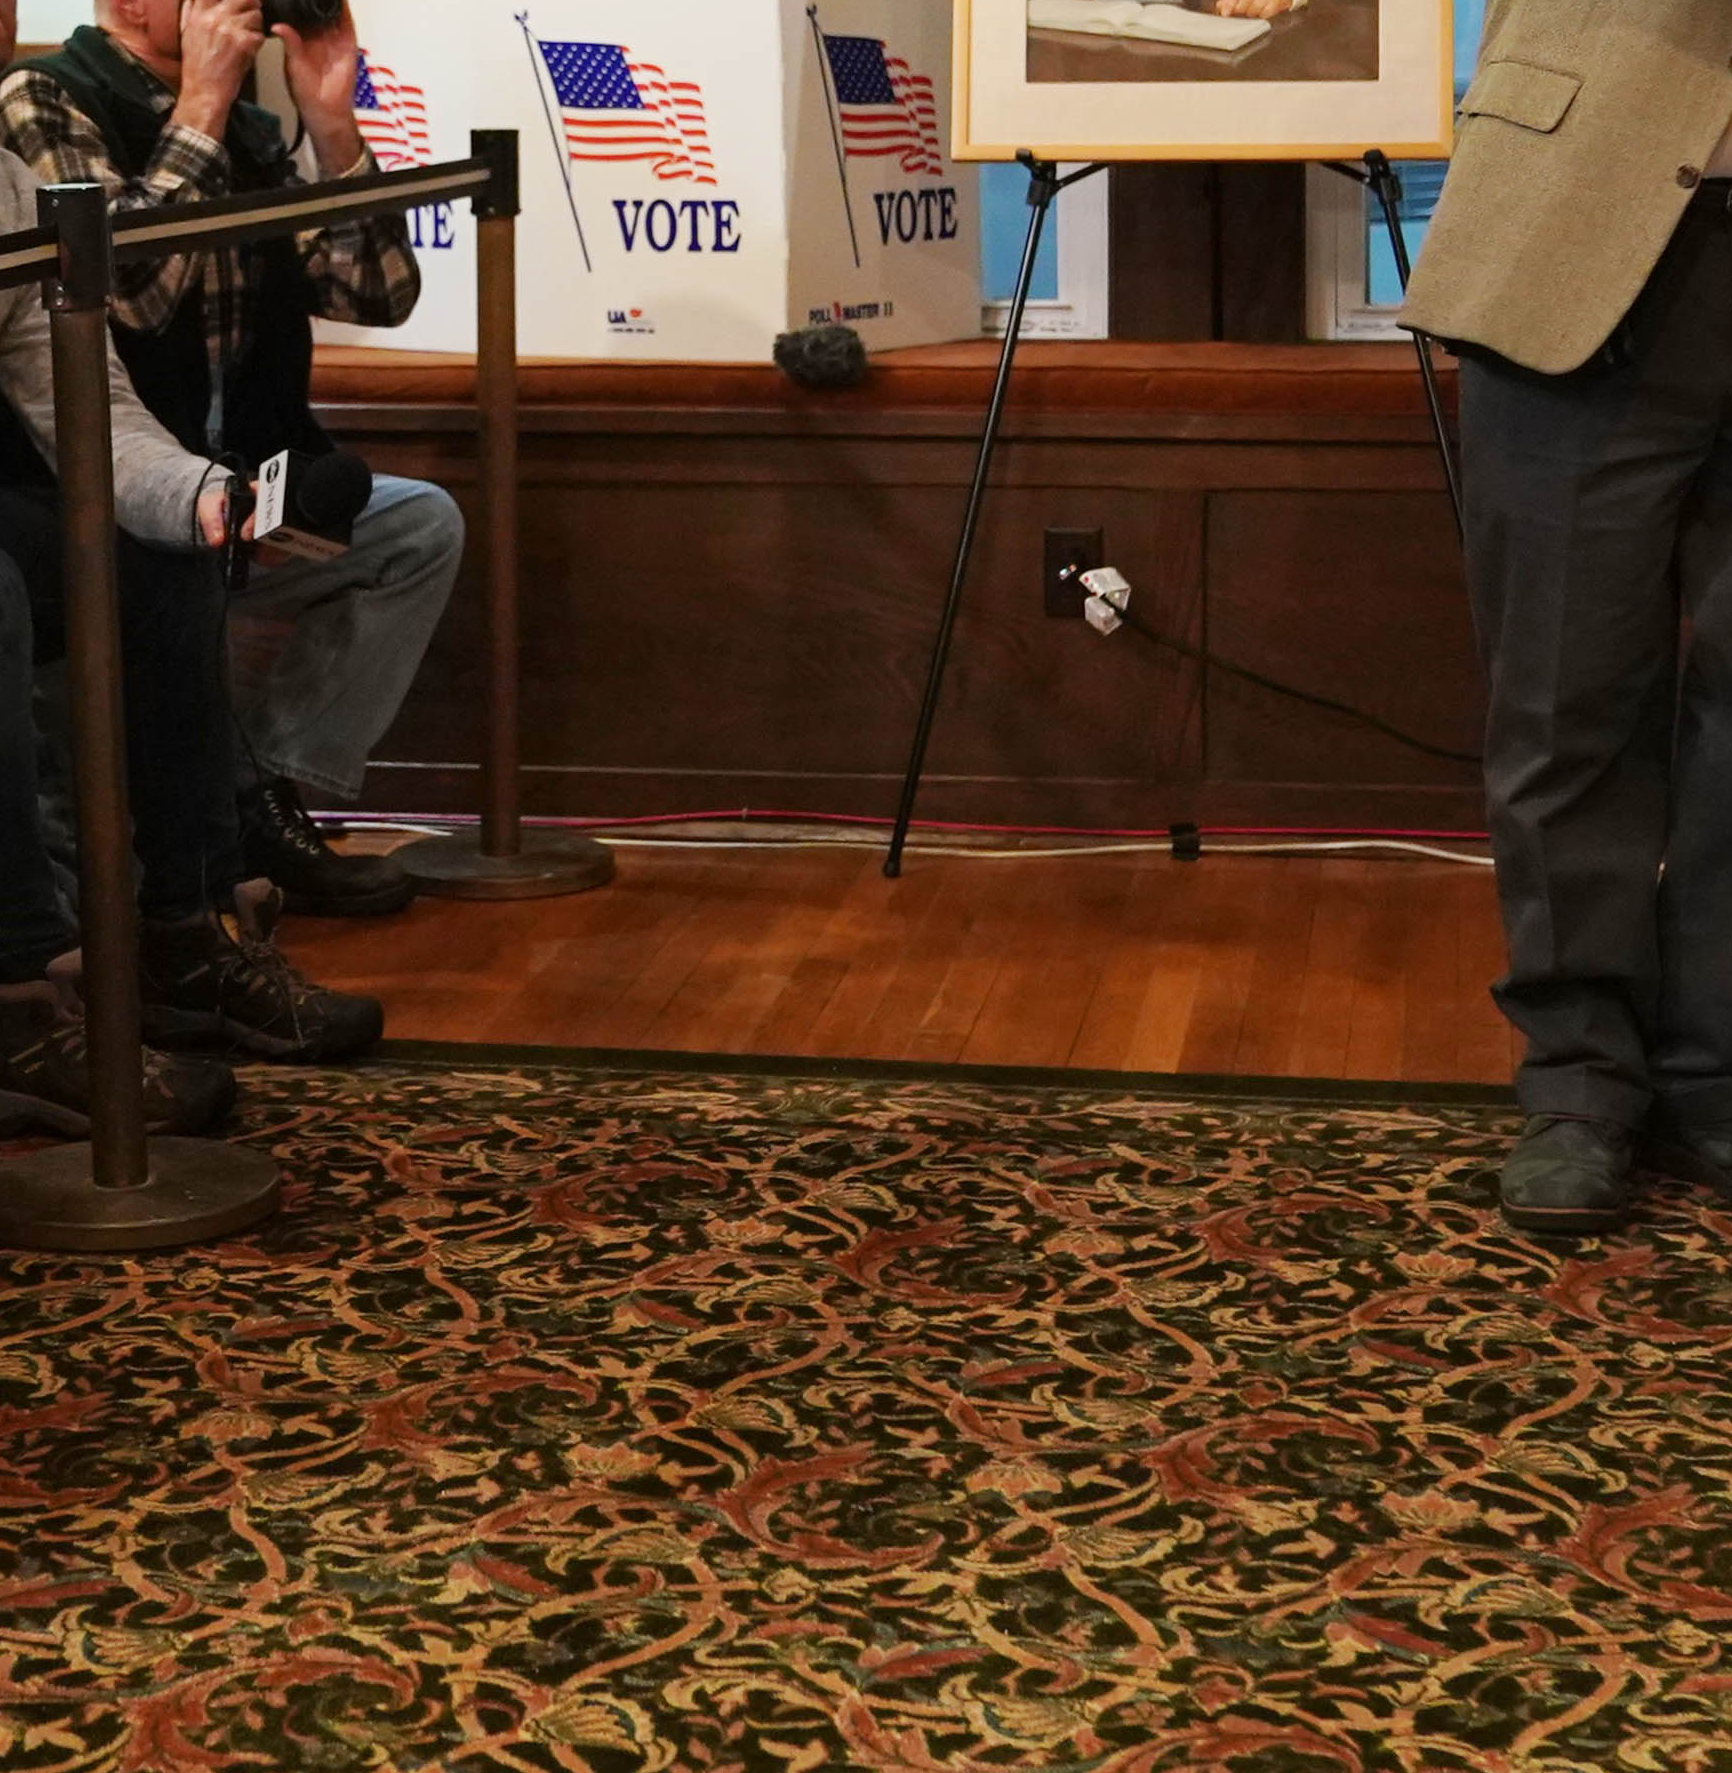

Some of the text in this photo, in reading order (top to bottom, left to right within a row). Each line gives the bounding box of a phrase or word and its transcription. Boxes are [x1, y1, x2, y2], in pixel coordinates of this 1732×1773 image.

[406, 201, 455, 249] TE
[613, 199, 741, 253] VOTE
[874, 188, 958, 243] VOTE
